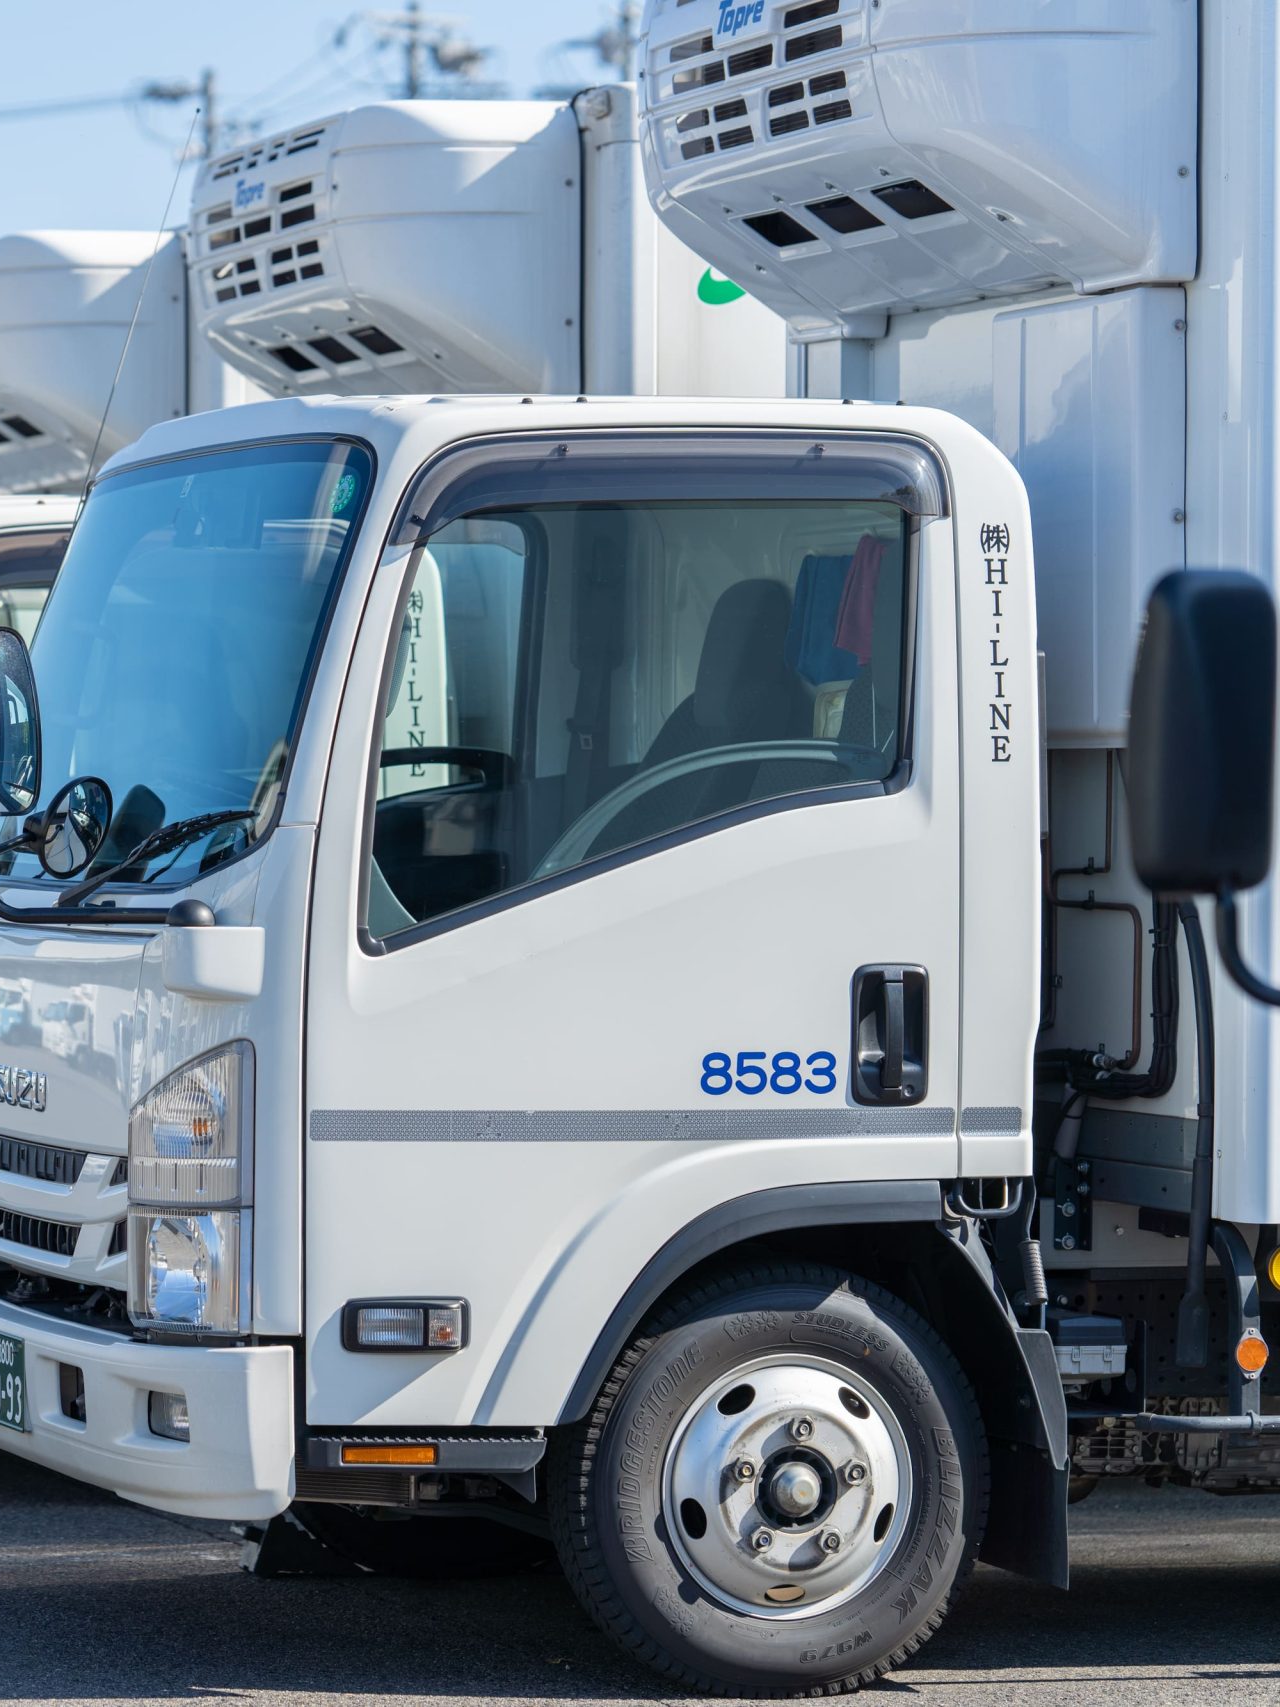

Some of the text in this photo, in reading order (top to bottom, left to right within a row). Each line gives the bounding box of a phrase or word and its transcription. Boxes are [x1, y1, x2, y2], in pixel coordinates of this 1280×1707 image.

[717, 0, 764, 36] Topre
[700, 1051, 837, 1096] 8583
[792, 1311, 890, 1352] STUDLESS
[618, 1340, 705, 1563] BRIDGESTONE
[890, 1426, 962, 1624] BLIZZAK
